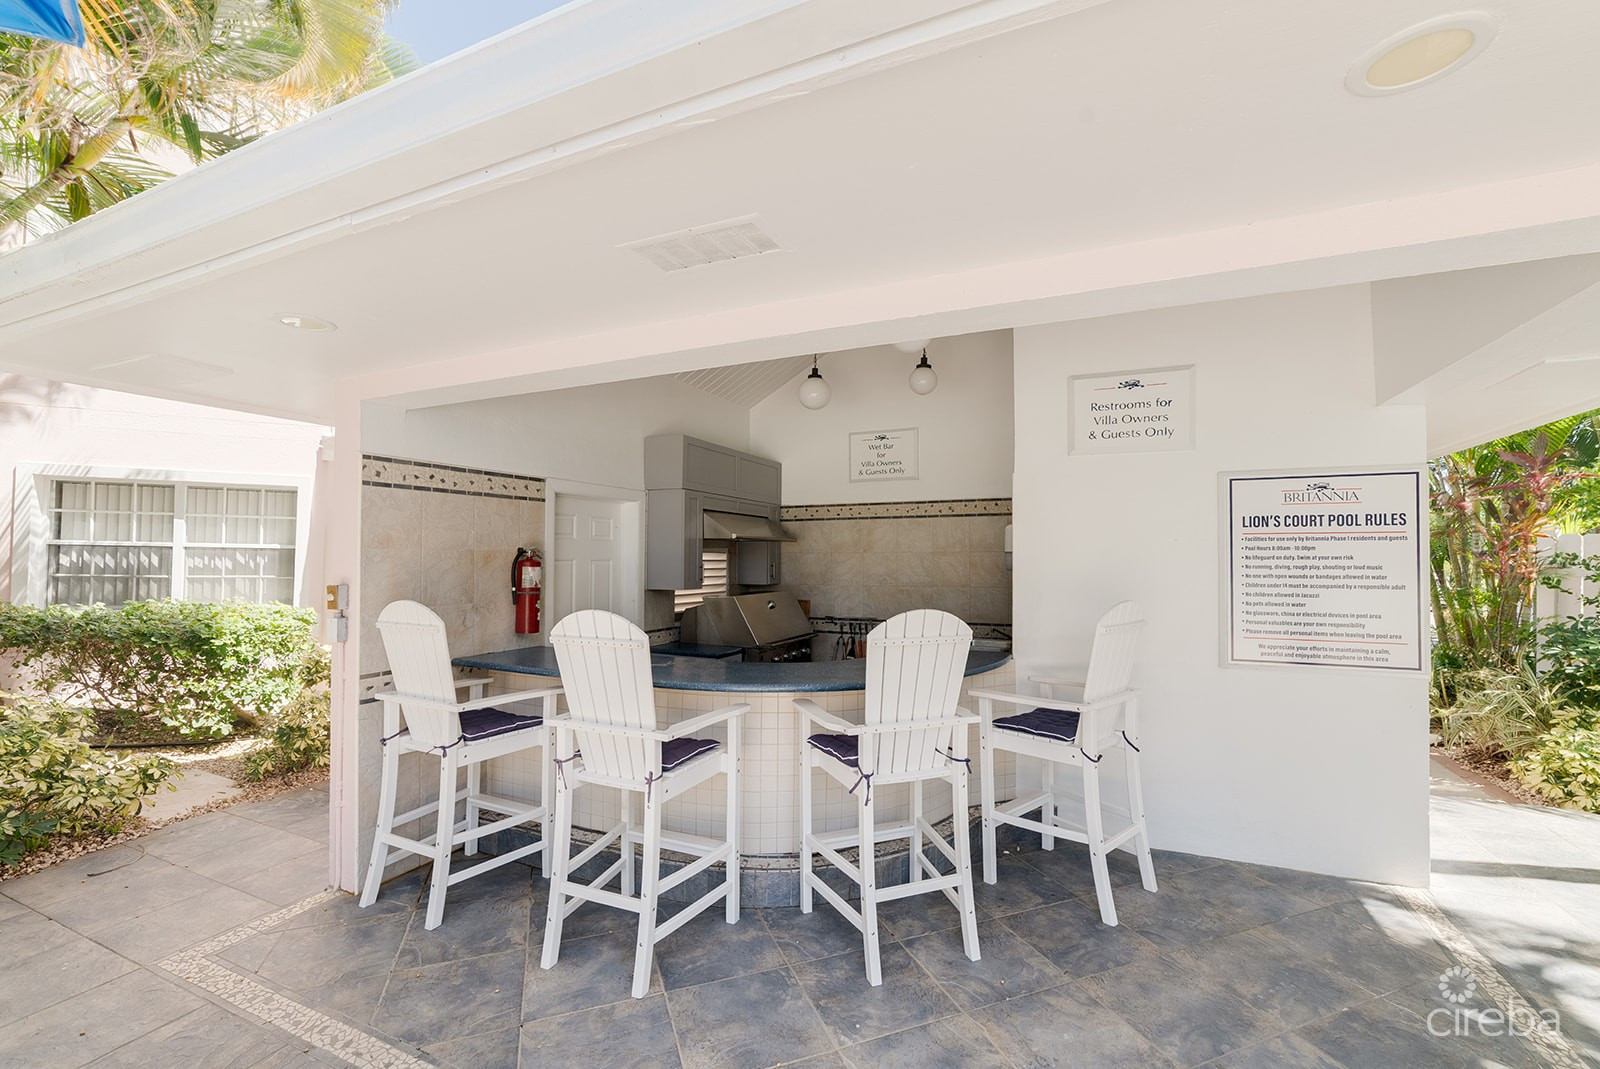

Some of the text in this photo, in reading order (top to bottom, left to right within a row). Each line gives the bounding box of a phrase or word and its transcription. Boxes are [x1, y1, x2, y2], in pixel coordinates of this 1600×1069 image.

[1090, 398, 1172, 412] Restrooms for
[1094, 414, 1168, 425] Villa Owners
[1088, 427, 1174, 440] & Guests Only
[1284, 491, 1360, 502] BRITANNIA
[1242, 512, 1407, 528] LION'S COURT POOL RULES
